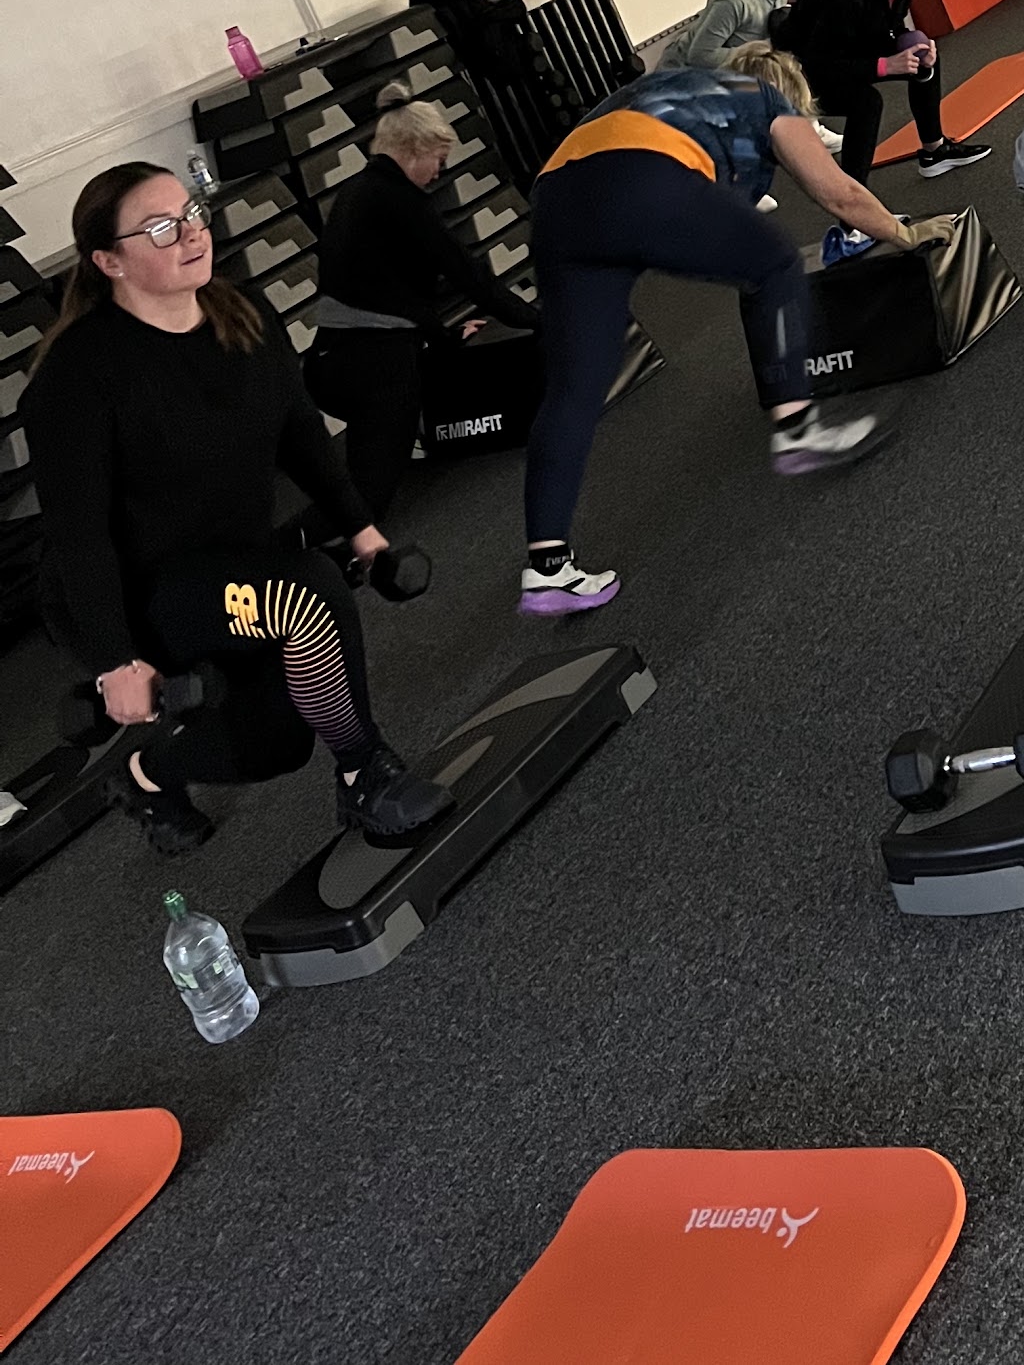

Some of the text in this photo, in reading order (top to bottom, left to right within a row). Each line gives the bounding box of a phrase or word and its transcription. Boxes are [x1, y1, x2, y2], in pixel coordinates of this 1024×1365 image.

[803, 350, 854, 376] RAFIT
[448, 414, 502, 439] MIRAFIT
[7, 1152, 70, 1176] beemat
[684, 1207, 777, 1234] beemat
